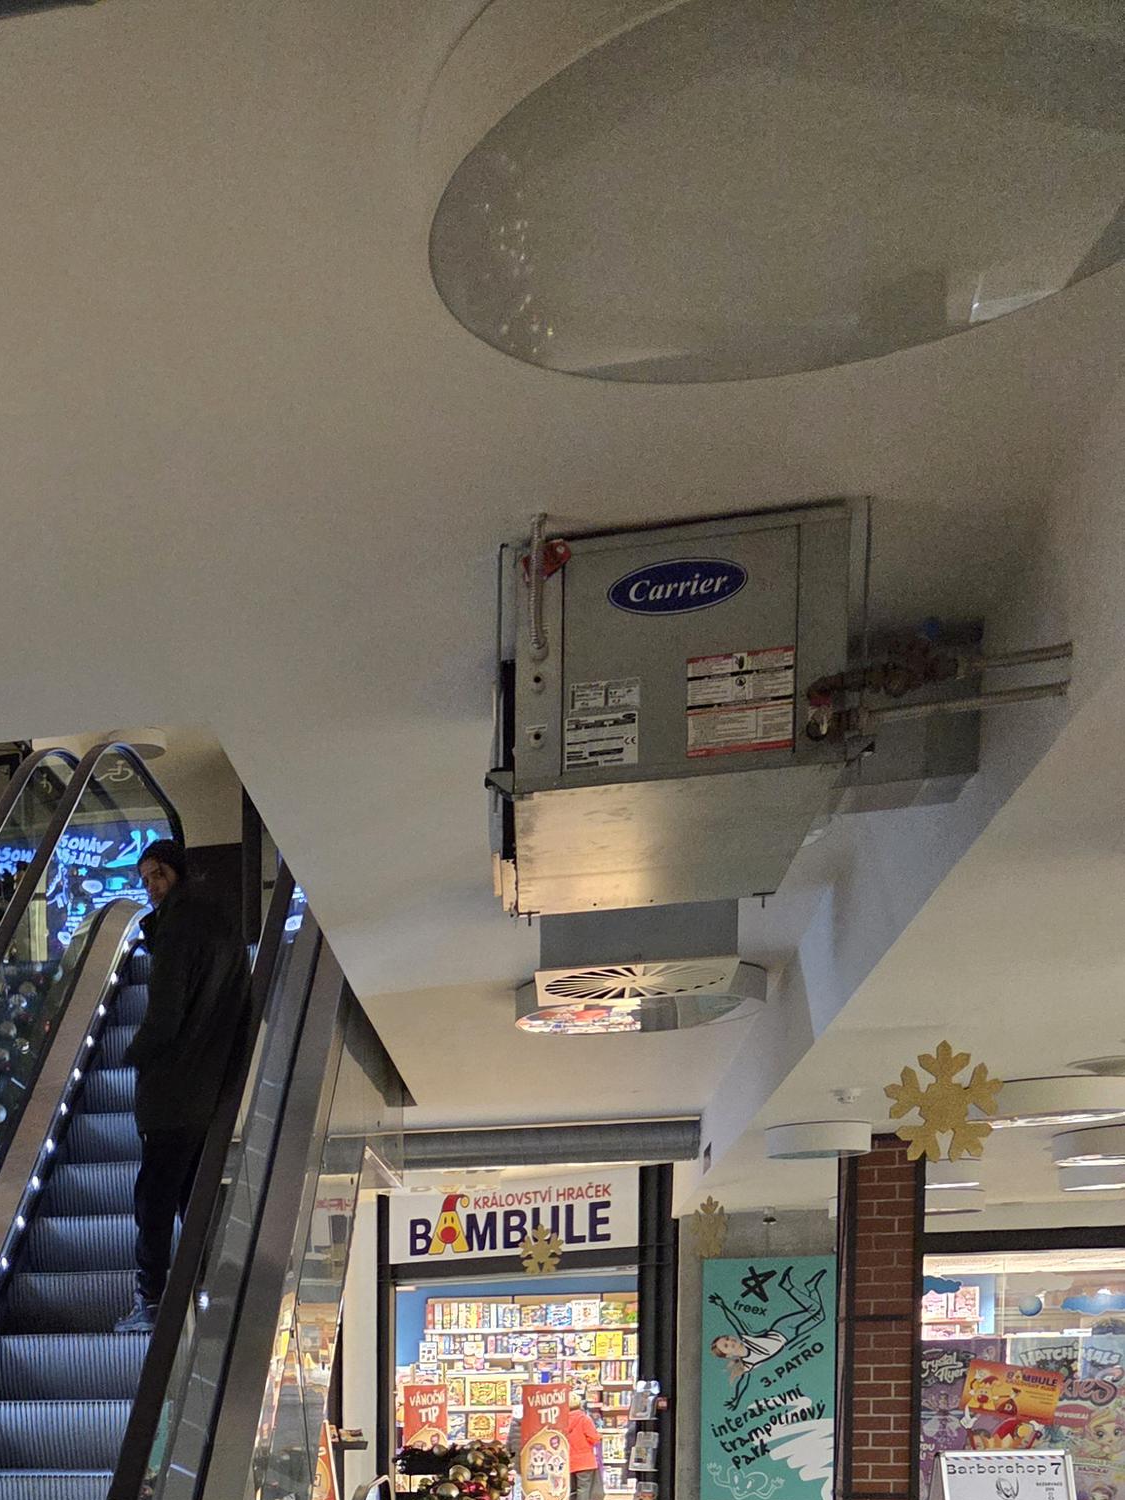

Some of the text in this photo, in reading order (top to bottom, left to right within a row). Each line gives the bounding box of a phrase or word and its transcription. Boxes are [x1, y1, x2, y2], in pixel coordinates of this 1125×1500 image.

[629, 573, 728, 602] Carrier
[473, 1182, 612, 1210] KRÁLOVSTVÍ HRAČEK
[409, 1197, 612, 1256] BAMBULE
[733, 1300, 768, 1317] freex
[760, 1342, 825, 1388] 3. PATRO
[1020, 1347, 1122, 1367] HATCHALS
[409, 1389, 445, 1407] VÁNOČNÍ
[527, 1388, 567, 1407] VÁNOČNÍ
[418, 1405, 440, 1424] TIP
[537, 1405, 560, 1424] TIP
[711, 1383, 805, 1438] interaktivní
[720, 1400, 826, 1453] trampolínový
[946, 1463, 1047, 1475] Barbershop
[1050, 1462, 1062, 1475] 7
